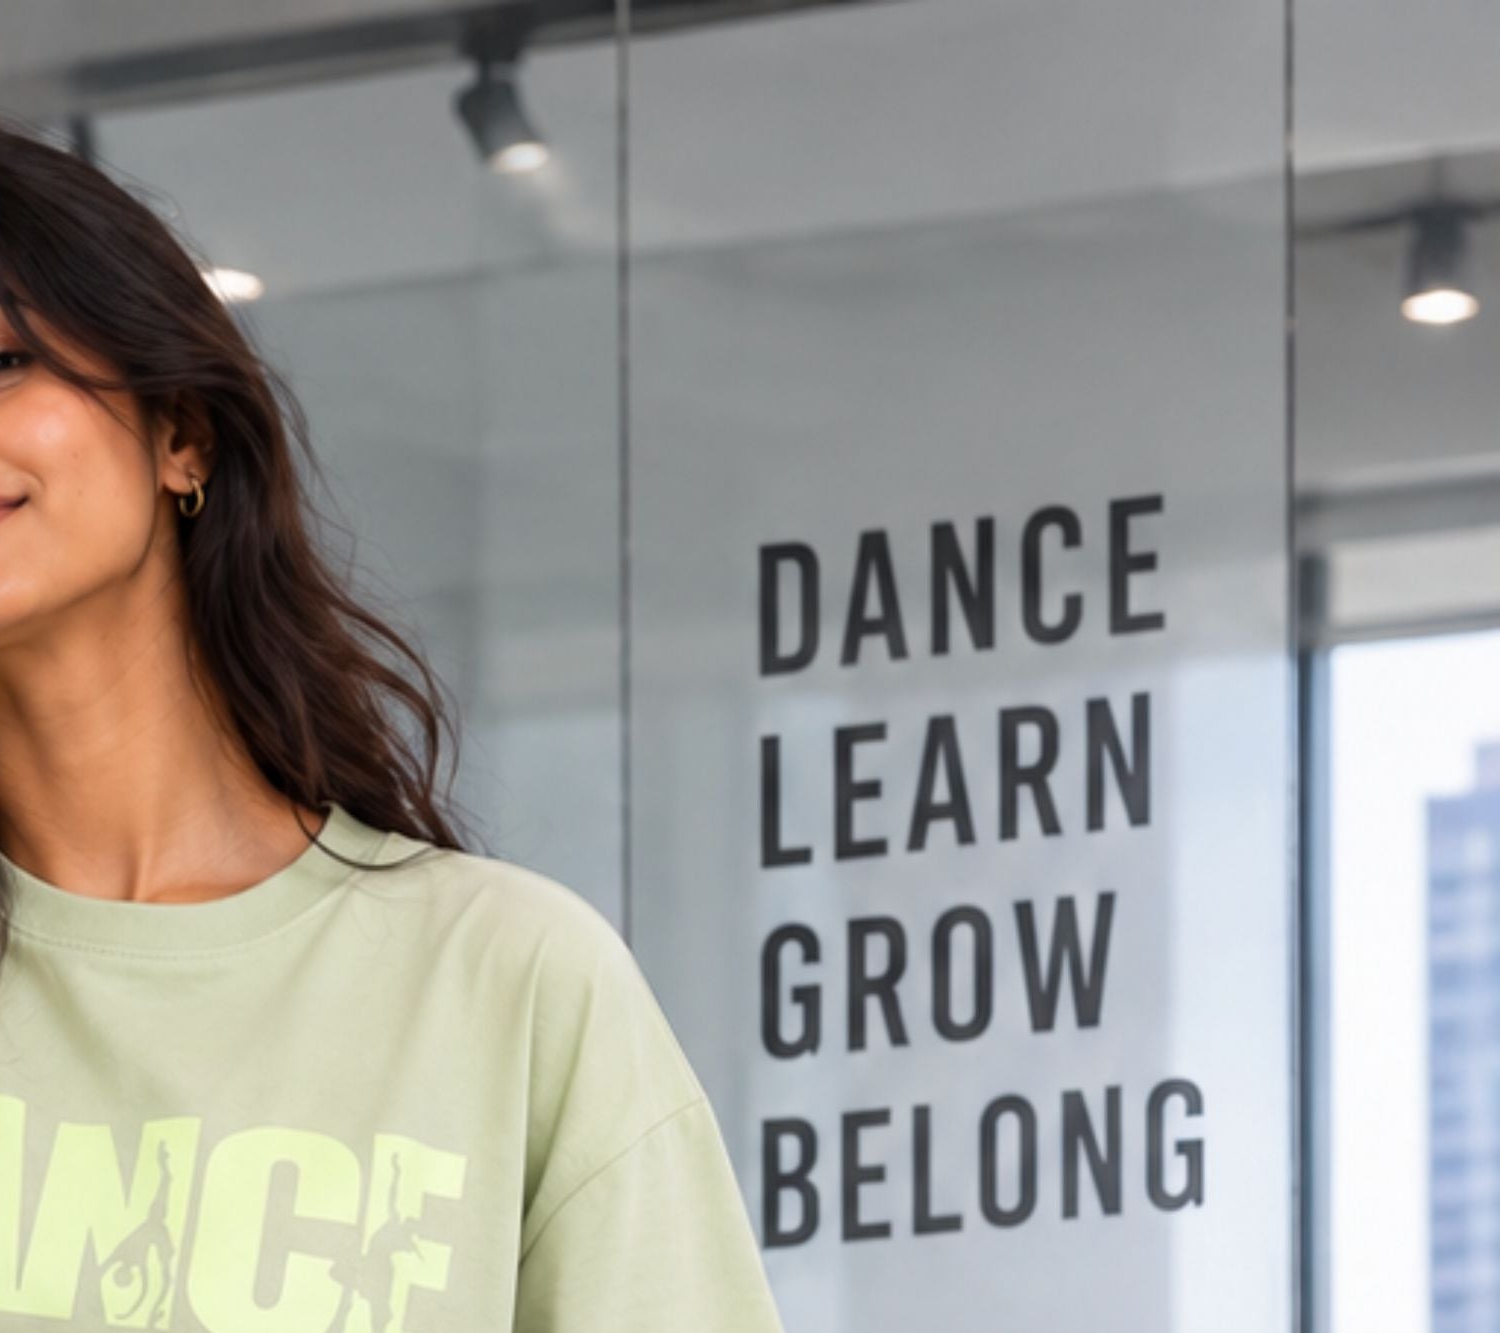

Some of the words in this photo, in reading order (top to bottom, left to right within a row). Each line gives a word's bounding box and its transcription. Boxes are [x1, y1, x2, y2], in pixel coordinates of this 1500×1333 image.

[757, 492, 1167, 679] DANCE
[759, 691, 1153, 869] LEARN
[759, 890, 1117, 1060] GROW
[760, 1077, 1206, 1250] BELONG
